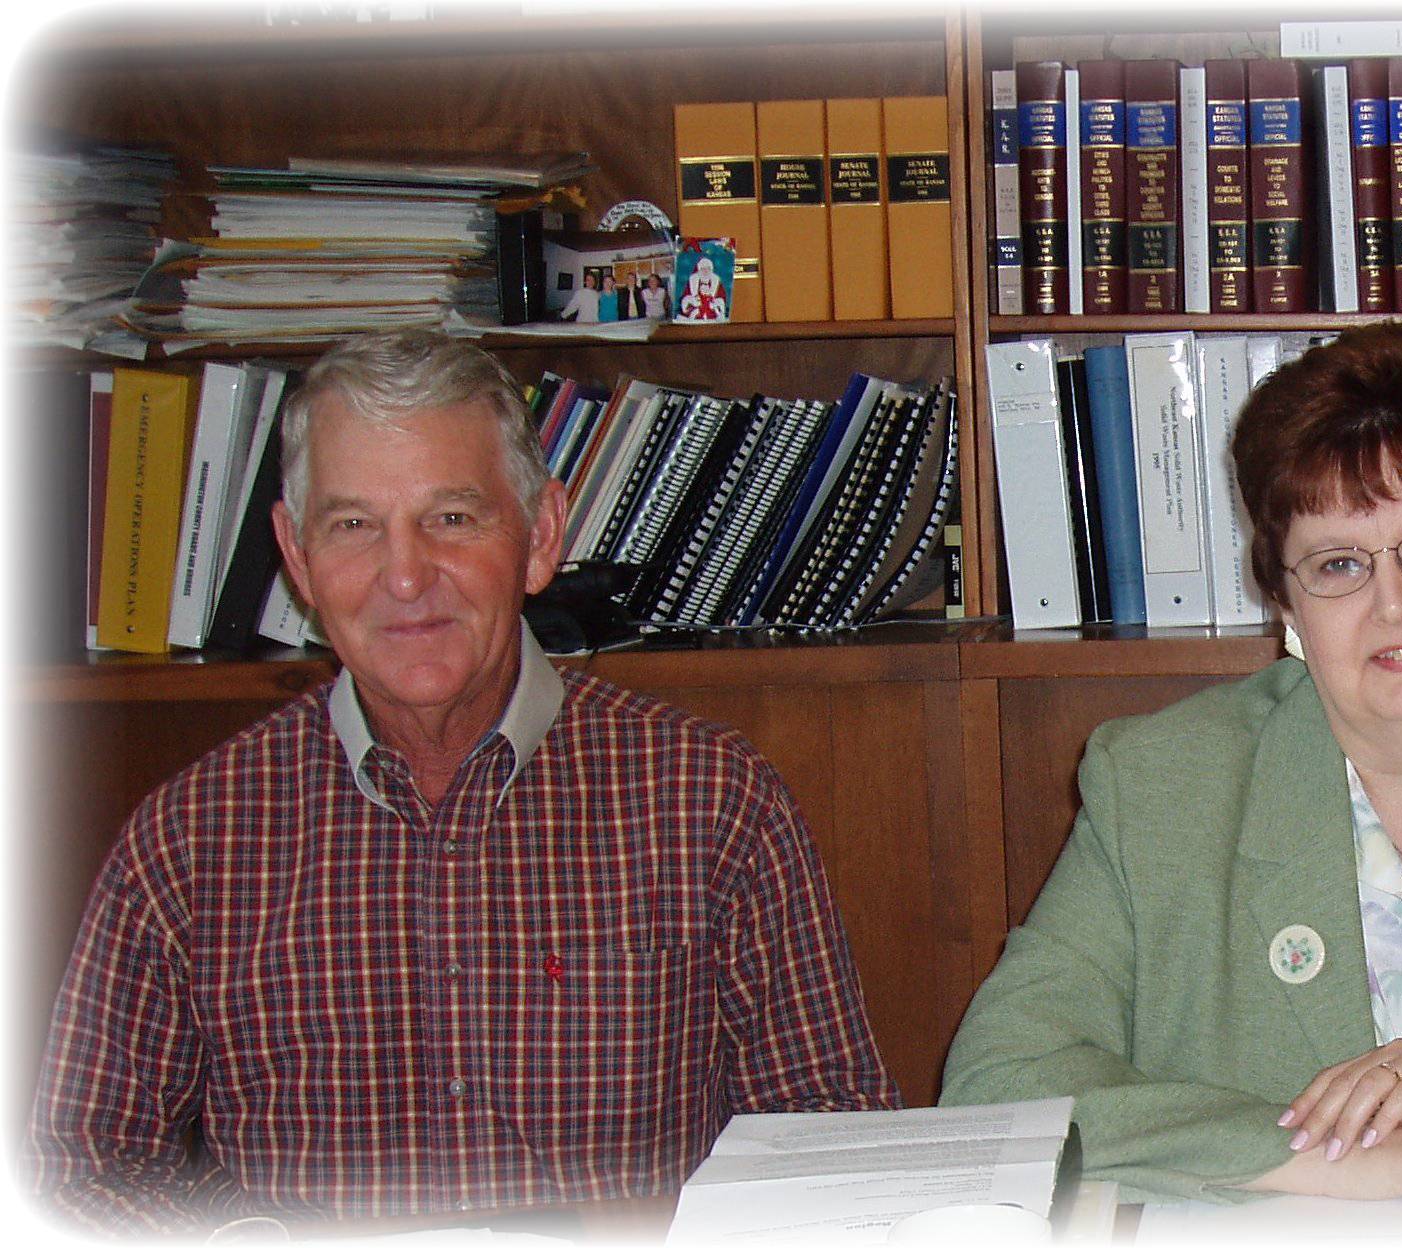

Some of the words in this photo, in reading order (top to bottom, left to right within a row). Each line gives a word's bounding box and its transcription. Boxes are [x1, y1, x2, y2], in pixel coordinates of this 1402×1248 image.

[777, 172, 809, 180] JOURNAL
[838, 170, 871, 178] JOURNAL
[906, 168, 939, 176] JOURNAL
[1160, 405, 1168, 423] Solid
[1169, 386, 1178, 421] Northeast
[136, 405, 150, 487] EMERGENCY
[1174, 452, 1182, 470] Solid
[1163, 450, 1171, 496] Management
[194, 506, 204, 530] COUNTY
[1175, 498, 1184, 531] Authority
[129, 494, 144, 577] OPERATIONS
[191, 532, 200, 553] ROADS
[187, 554, 197, 568] AND
[952, 553, 960, 571] JVC
[184, 569, 195, 597] BRIDGES
[127, 581, 139, 616] PLAN
